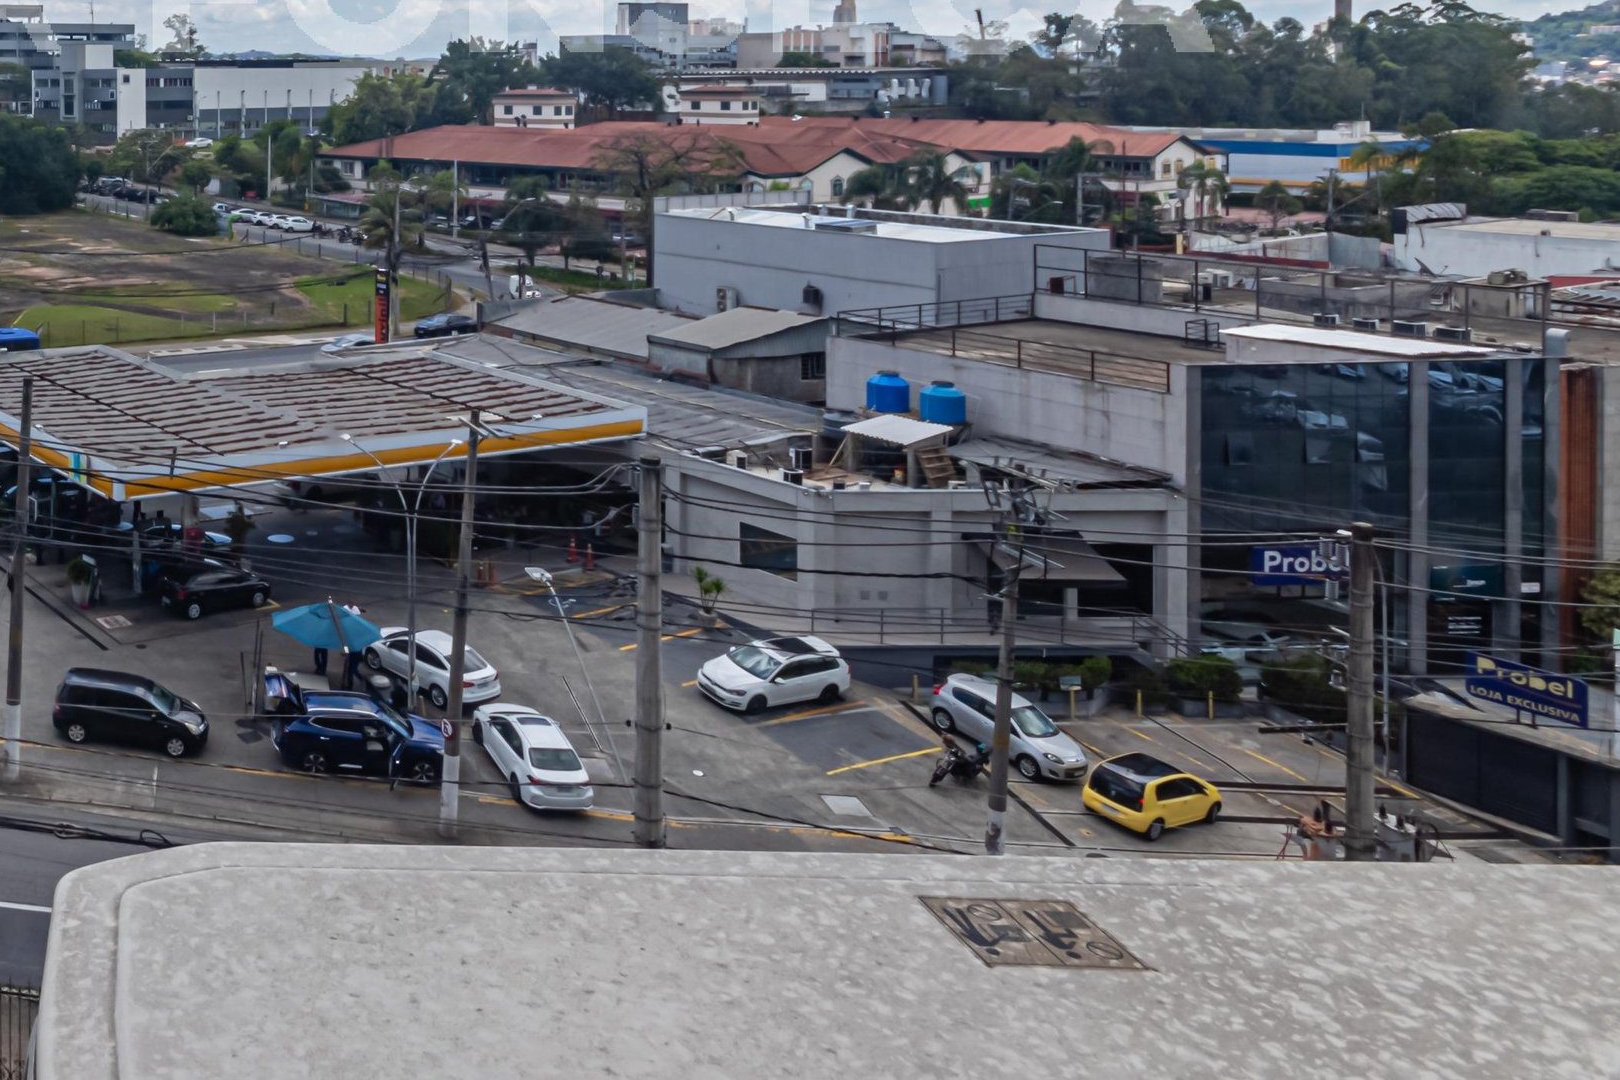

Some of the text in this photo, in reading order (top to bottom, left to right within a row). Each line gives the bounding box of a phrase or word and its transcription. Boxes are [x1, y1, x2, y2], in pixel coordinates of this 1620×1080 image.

[1476, 656, 1573, 699] Probel
[1469, 685, 1580, 722] LOJA EXCLUSIVA
